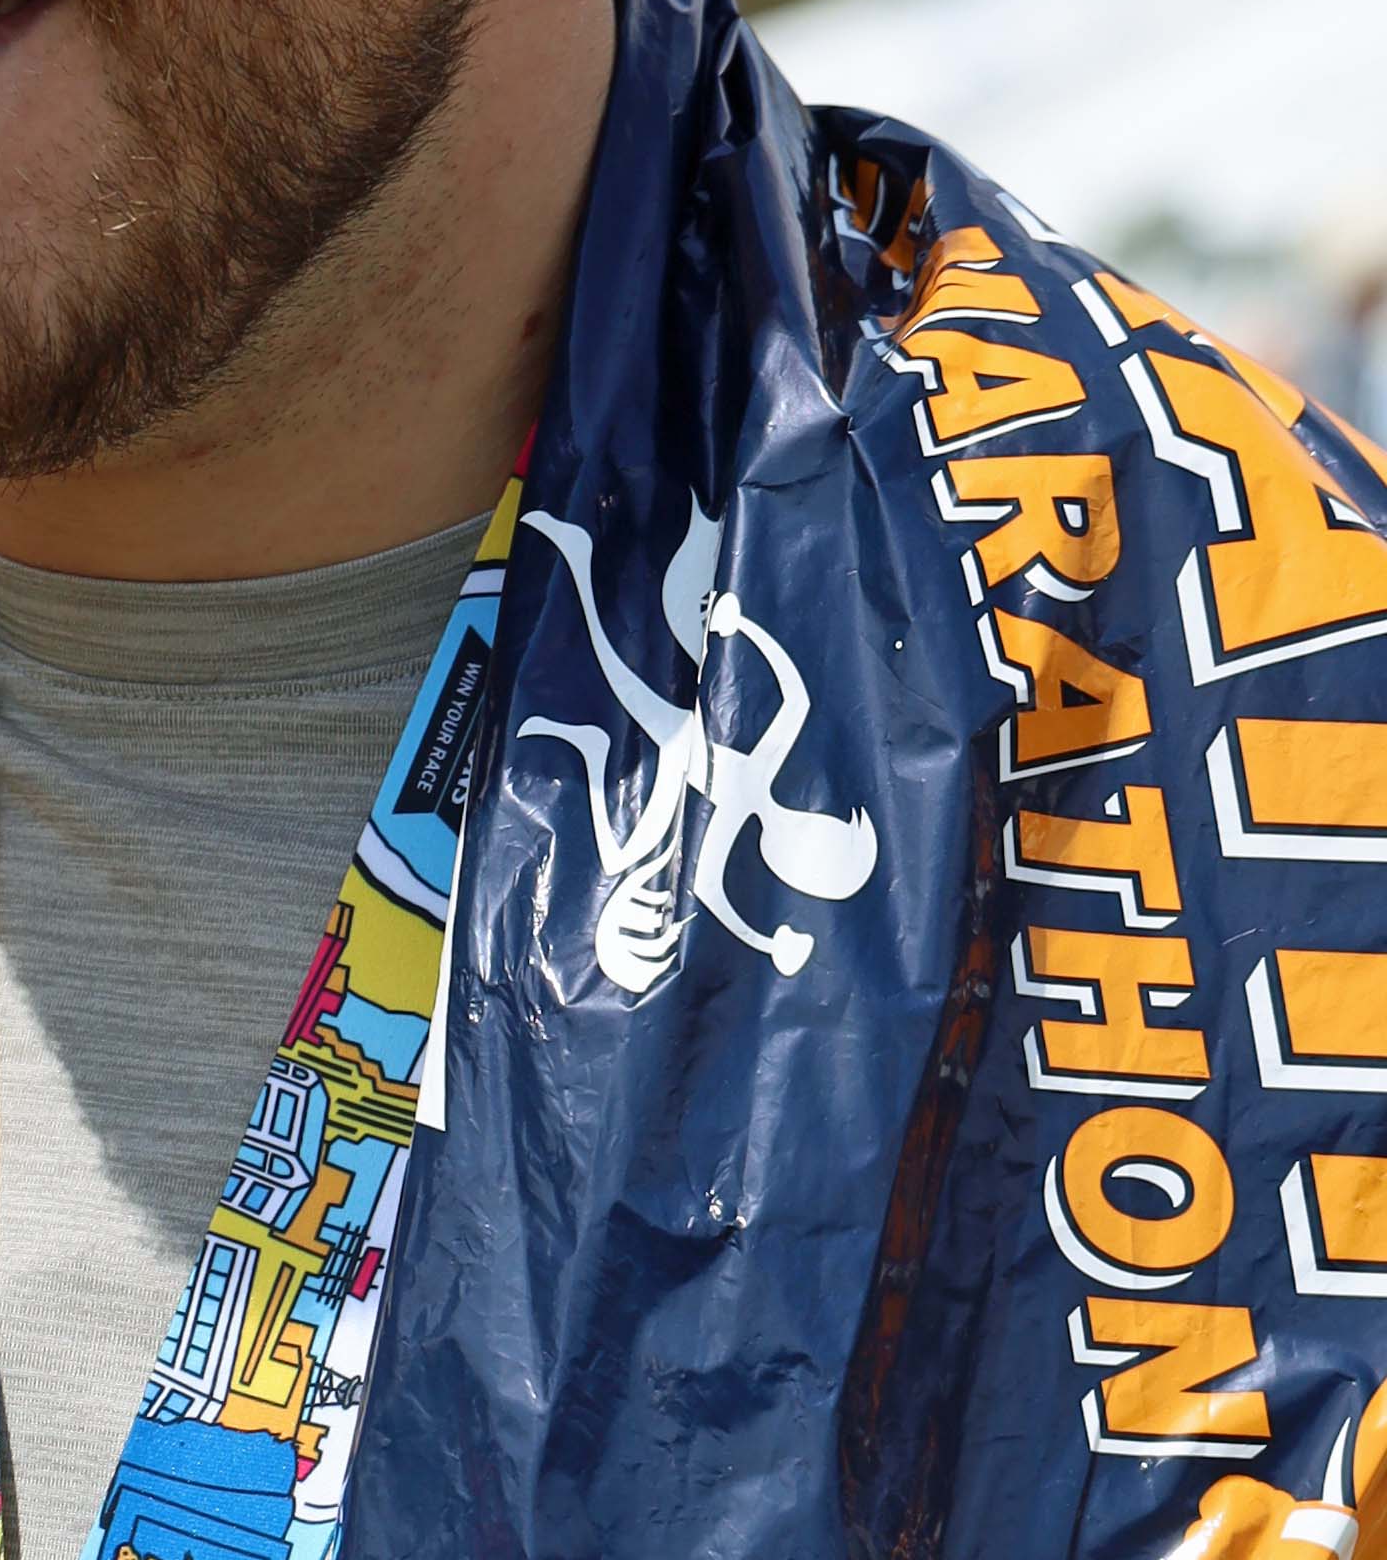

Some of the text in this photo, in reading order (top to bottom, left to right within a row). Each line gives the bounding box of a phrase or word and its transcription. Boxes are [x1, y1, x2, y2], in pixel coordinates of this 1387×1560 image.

[457, 661, 482, 696] WIN
[437, 697, 468, 744] YOUR
[417, 745, 447, 793] RACE
